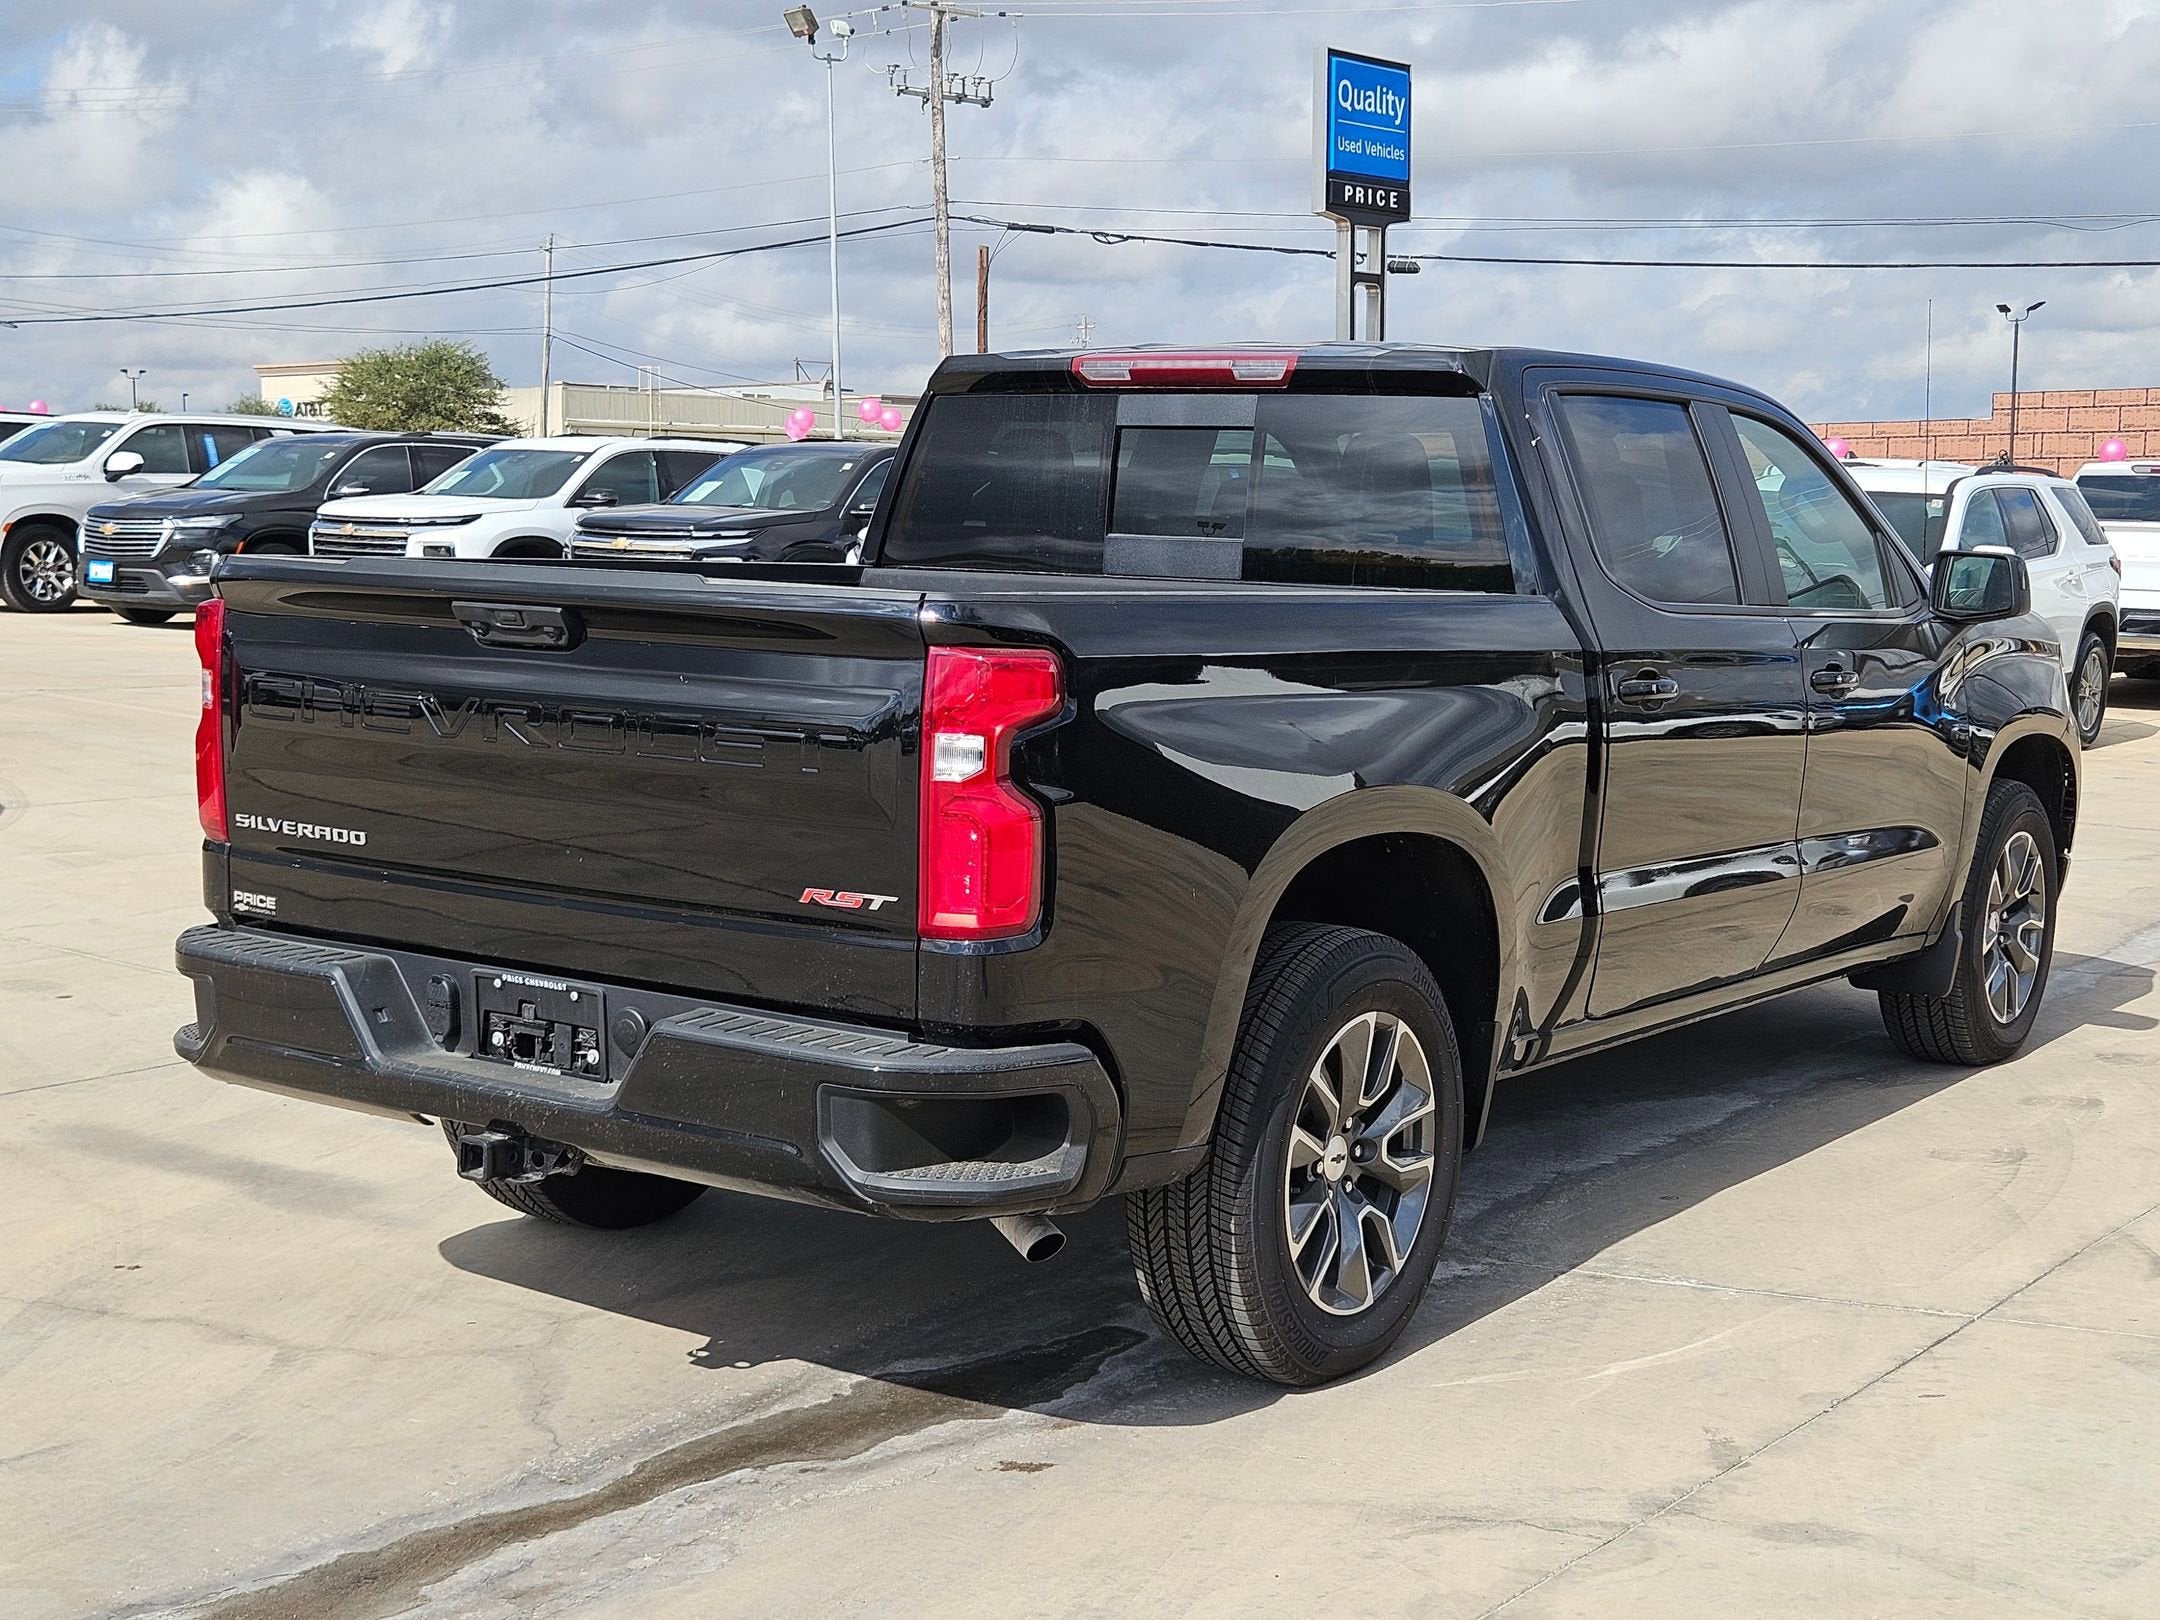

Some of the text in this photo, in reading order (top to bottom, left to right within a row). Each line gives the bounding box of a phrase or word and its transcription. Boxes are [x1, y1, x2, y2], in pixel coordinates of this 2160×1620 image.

[1337, 79, 1406, 126] Quality
[1337, 135, 1406, 161] Used Vehicles
[1344, 185, 1399, 208] PRICE
[248, 674, 850, 773] CHEVROLET
[235, 813, 367, 846] SILVERADO
[233, 890, 277, 910] PRICE
[799, 887, 900, 911] RST
[502, 974, 567, 991] PRICE CHEVROLET
